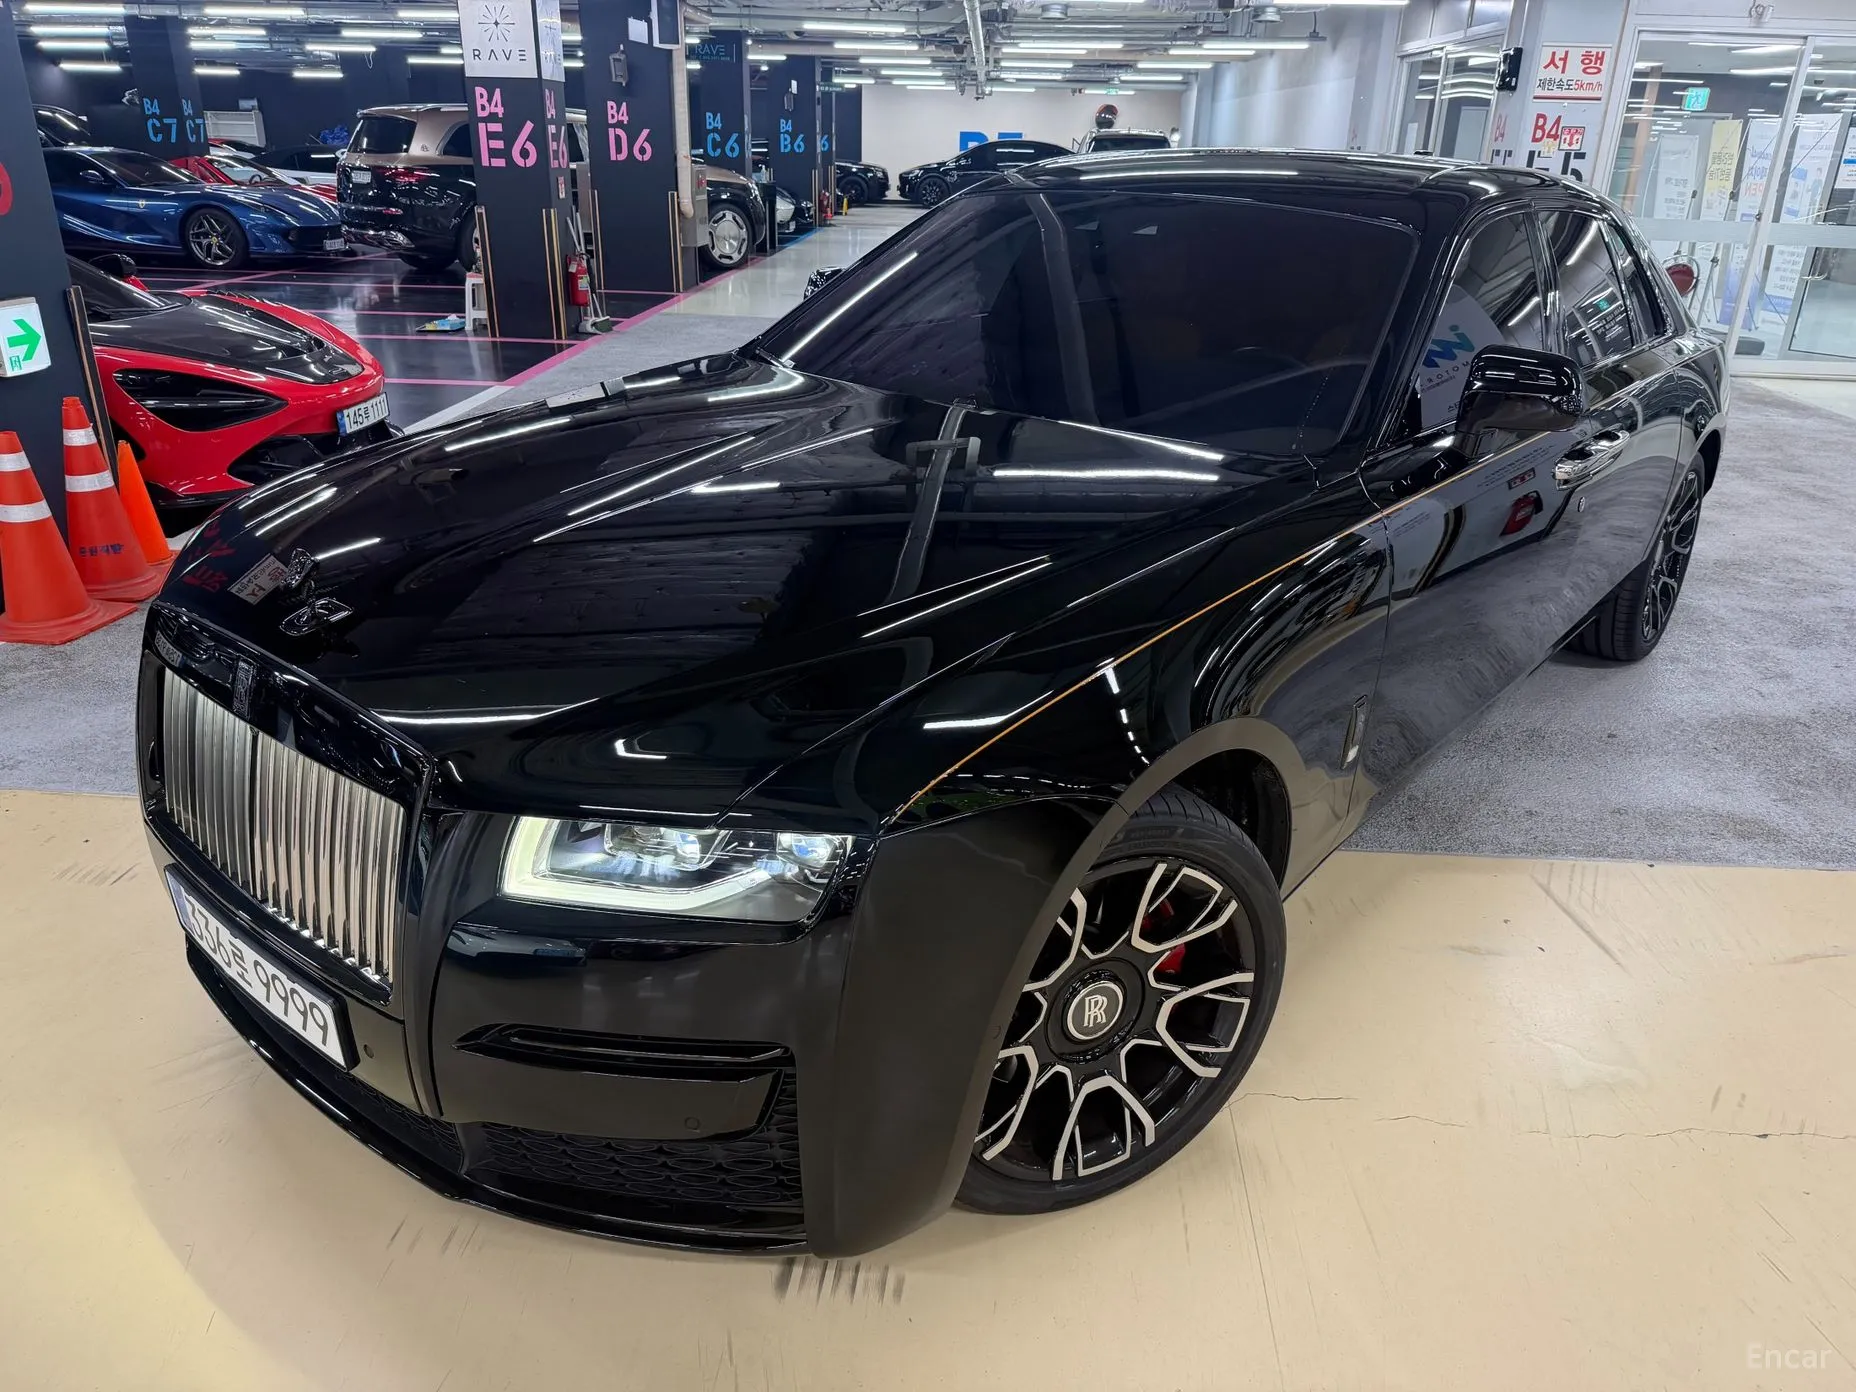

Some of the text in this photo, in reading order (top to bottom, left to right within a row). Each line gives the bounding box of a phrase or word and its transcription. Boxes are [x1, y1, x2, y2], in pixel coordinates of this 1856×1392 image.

[472, 48, 527, 61] RAVE
[143, 97, 160, 115] B4
[181, 98, 193, 116] B4
[474, 86, 505, 118] B4
[545, 88, 556, 119] B4
[607, 100, 629, 124] B4
[147, 118, 178, 143] C7
[186, 118, 204, 143] C7
[705, 112, 722, 130] B4
[780, 119, 793, 132] B4
[1531, 112, 1562, 143] B4
[478, 120, 538, 167] E6
[548, 124, 568, 168] E6
[608, 127, 652, 161] D6
[706, 133, 740, 158] C6
[780, 133, 805, 153] B6
[820, 134, 829, 152] 6
